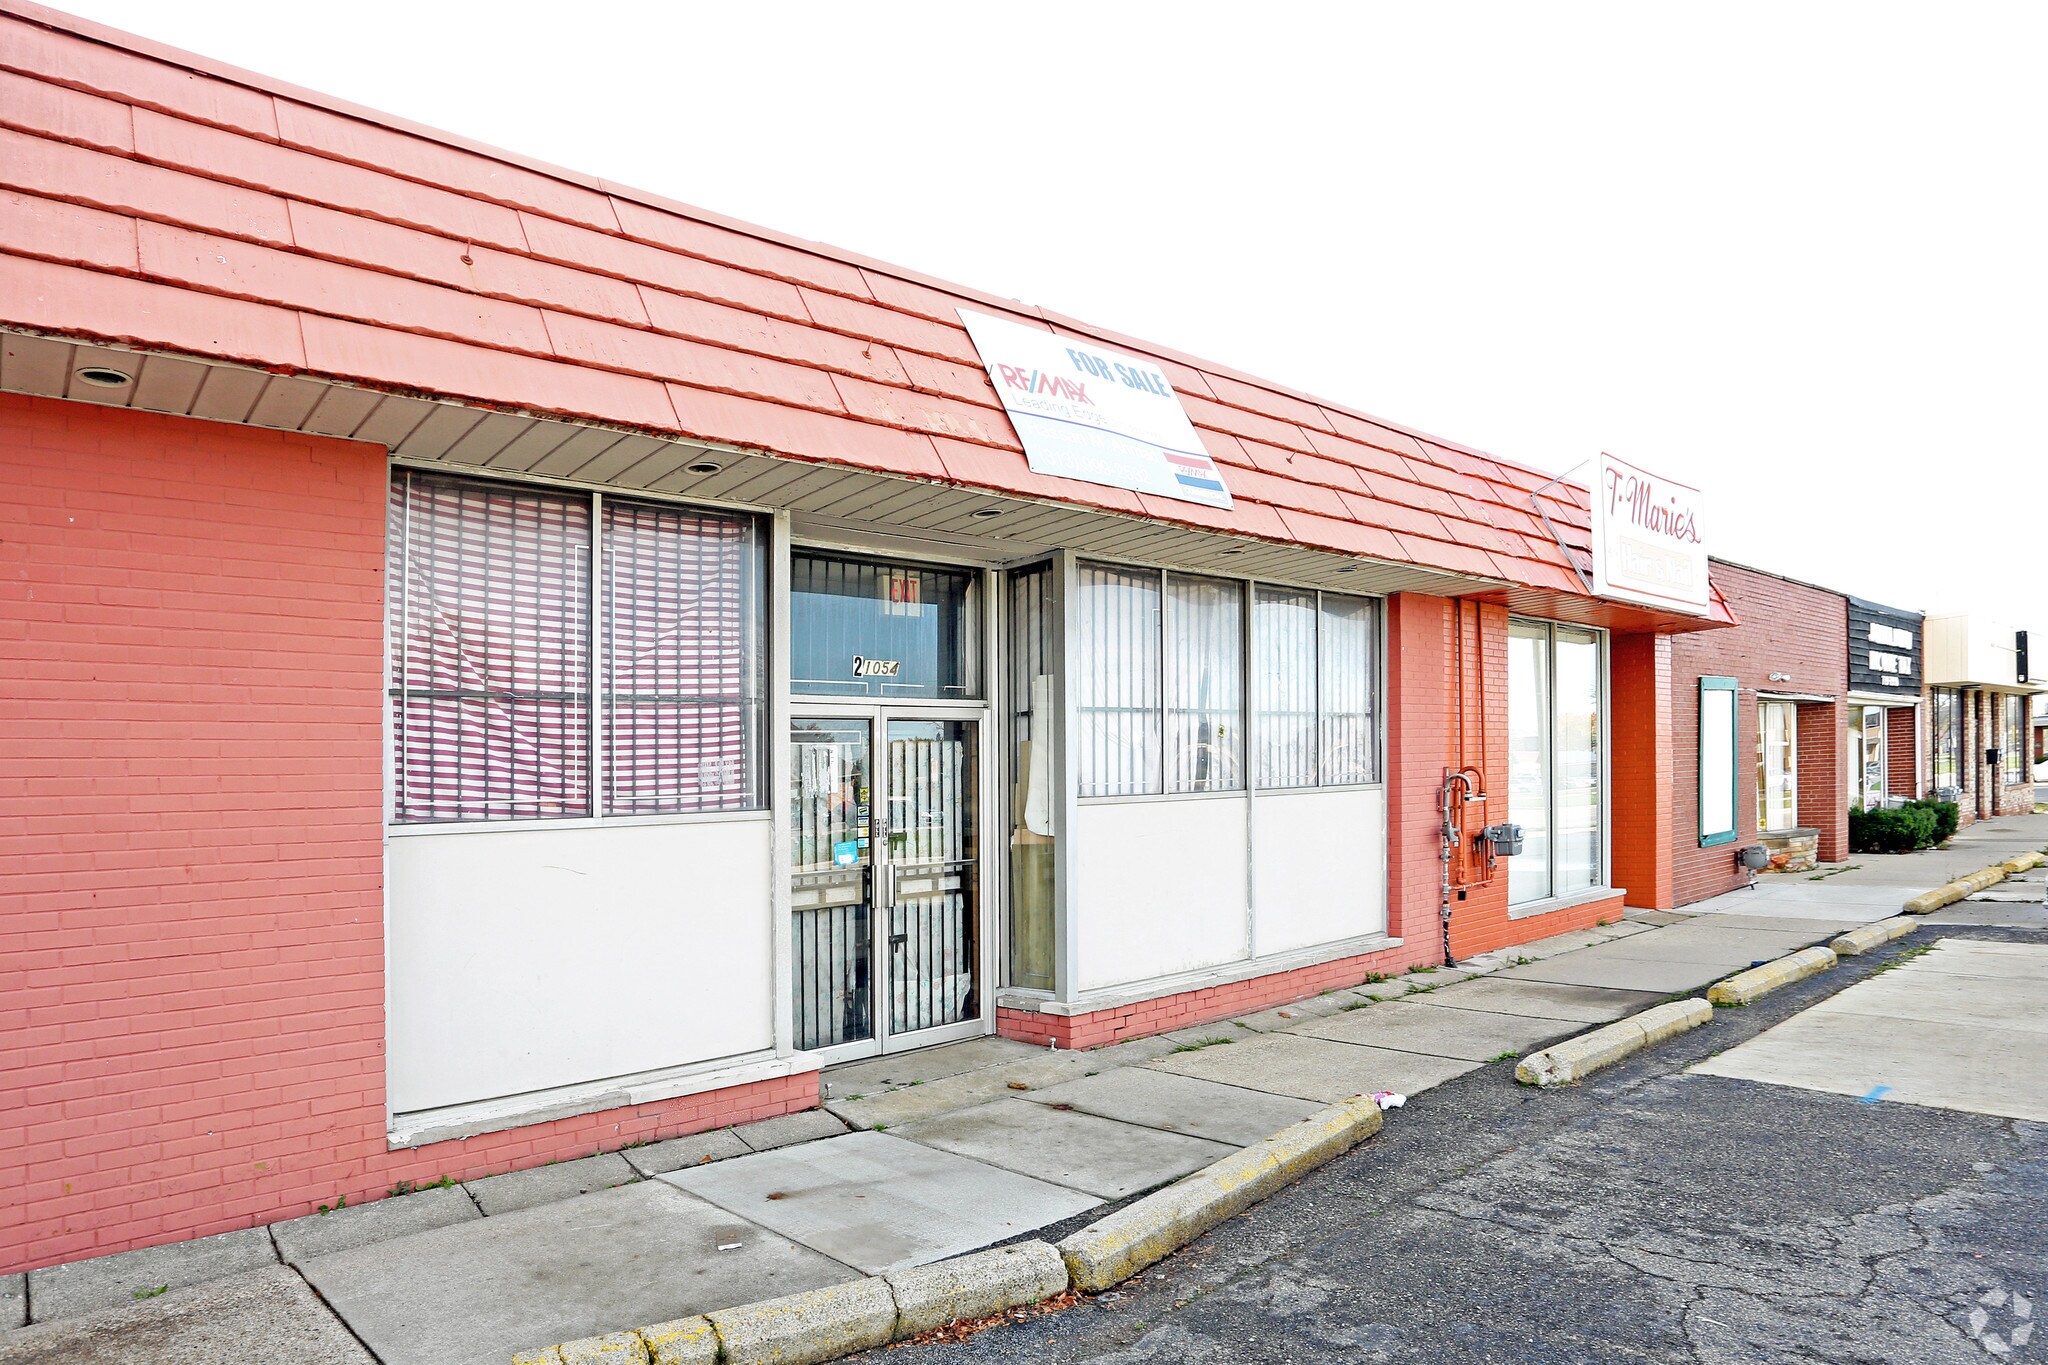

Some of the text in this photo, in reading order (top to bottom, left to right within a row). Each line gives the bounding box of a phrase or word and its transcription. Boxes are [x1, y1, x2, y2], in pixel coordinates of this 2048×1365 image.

[997, 363, 1096, 406] RE/MAX
[1065, 348, 1171, 398] FOR SALE
[1012, 393, 1071, 419] Leading
[1626, 476, 1701, 544] Marie's
[891, 578, 917, 603] EXIT
